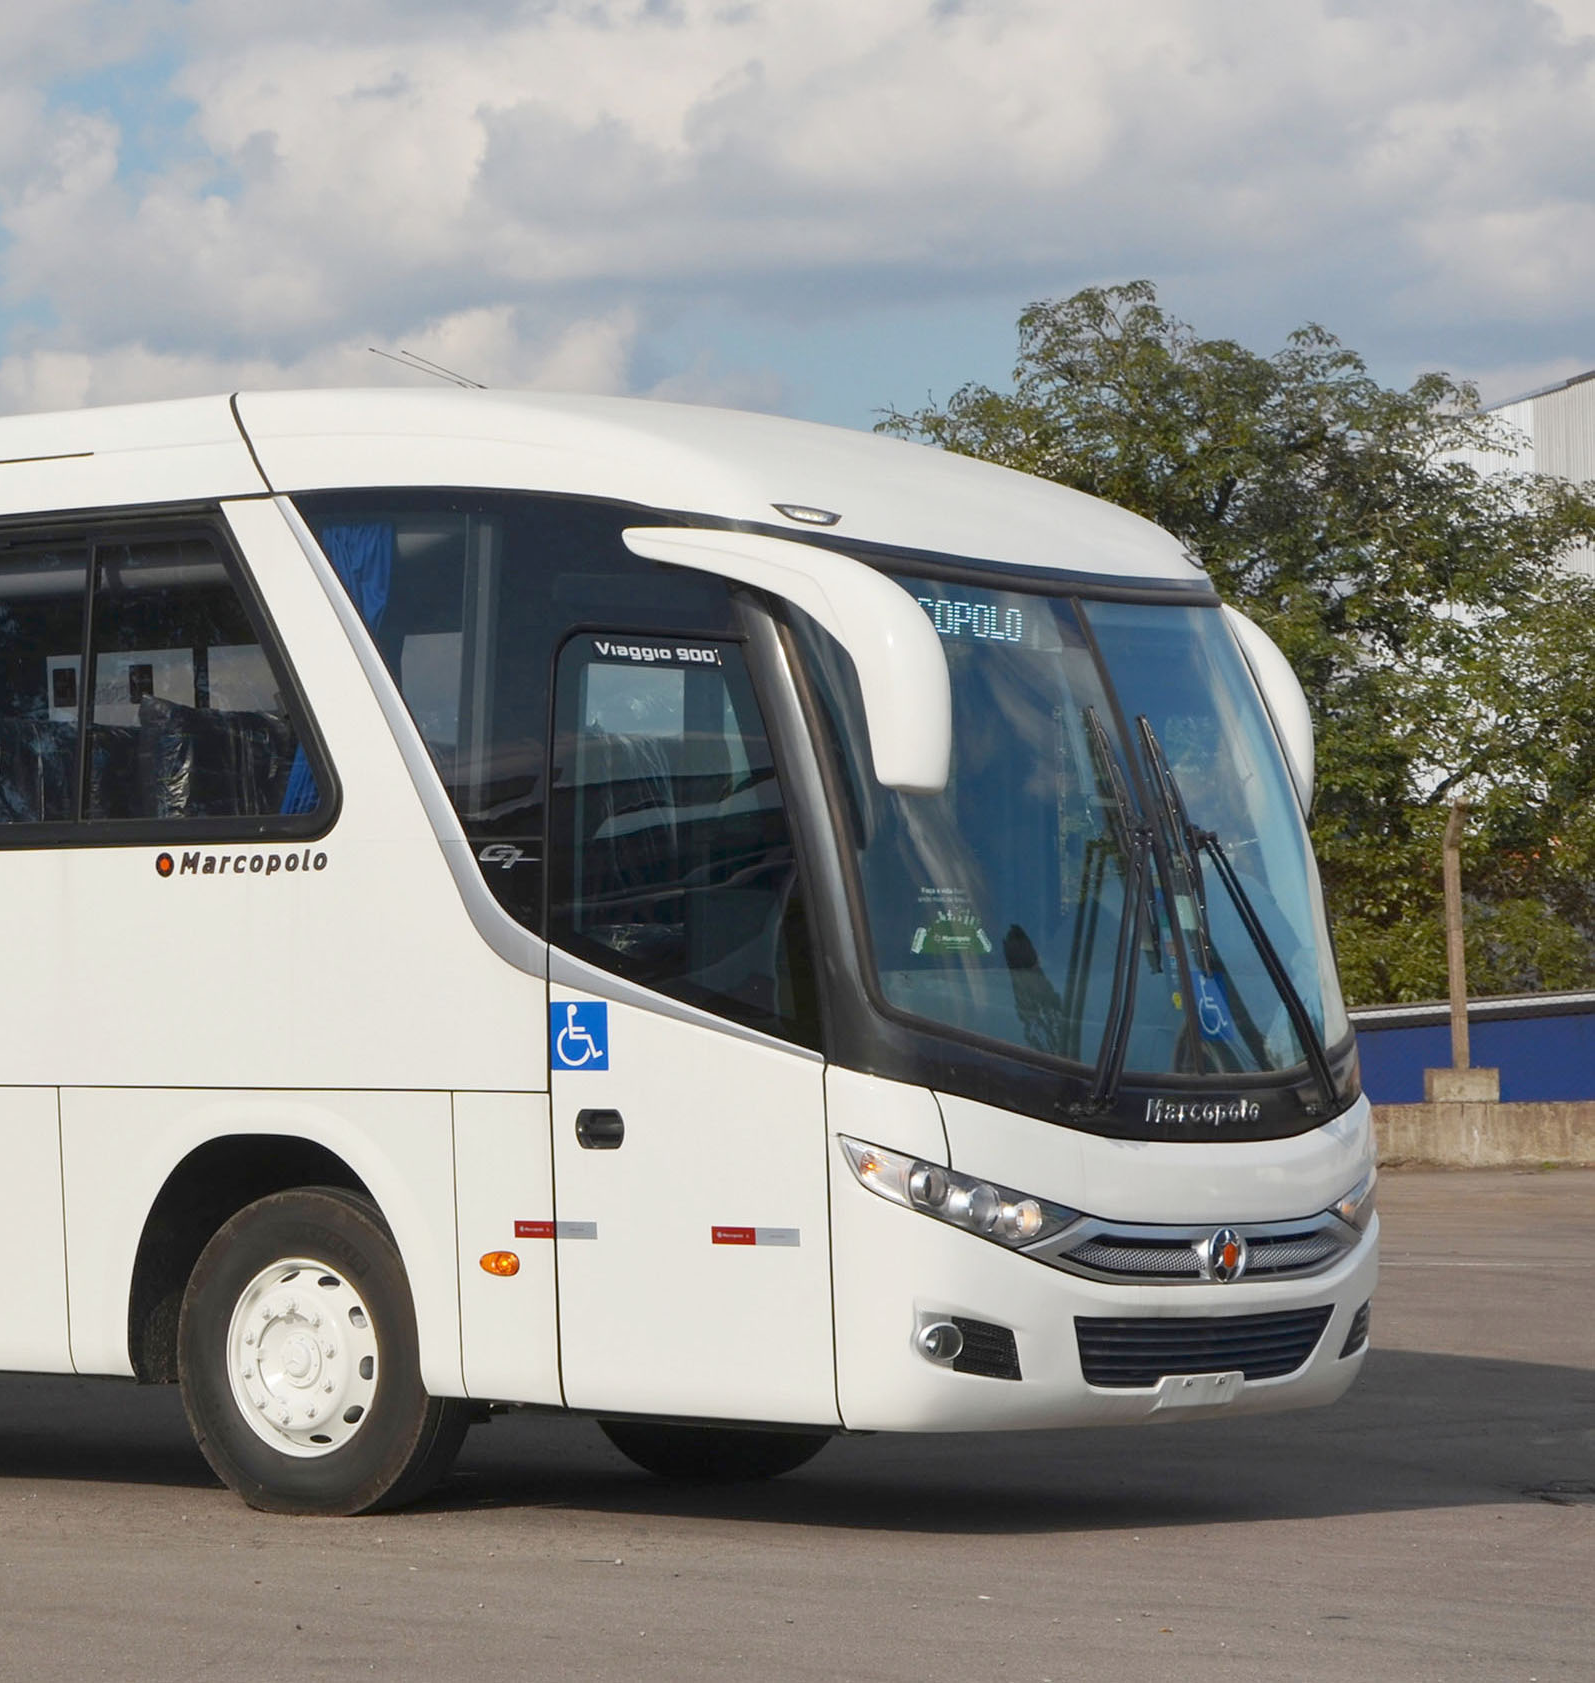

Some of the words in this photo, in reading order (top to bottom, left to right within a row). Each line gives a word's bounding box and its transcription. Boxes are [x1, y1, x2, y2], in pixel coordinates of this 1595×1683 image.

[594, 641, 672, 661] Viaggio
[675, 647, 716, 663] 900
[180, 849, 328, 876] Marcopolo
[479, 844, 540, 869] G7
[1146, 1098, 1261, 1126] Marcopolo
